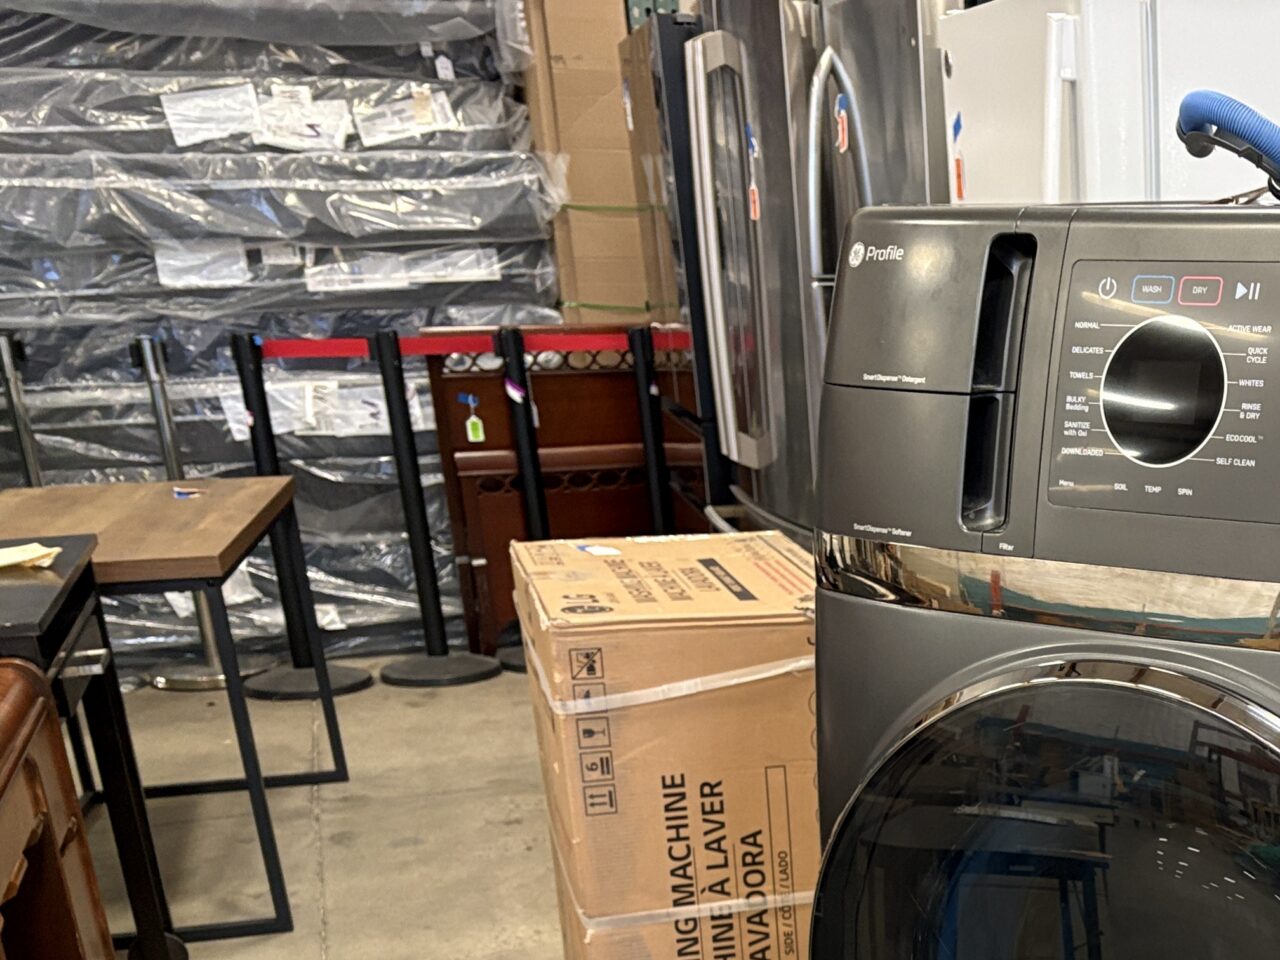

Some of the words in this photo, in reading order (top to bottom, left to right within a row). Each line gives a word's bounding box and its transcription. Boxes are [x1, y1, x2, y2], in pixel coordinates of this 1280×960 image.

[866, 245, 904, 261] Profile
[1142, 285, 1162, 293] WASH
[1192, 286, 1208, 294] DRY
[1074, 321, 1100, 329] NORMAL
[1227, 325, 1251, 333] ACTIVE
[1252, 325, 1272, 333] WEAR
[1071, 346, 1104, 354] DELICATES
[1247, 347, 1269, 355] QUICK
[1246, 356, 1267, 364] CYCLE
[1069, 371, 1094, 379] TOWELS
[1239, 379, 1264, 387] WHITES
[1241, 403, 1262, 411] RINSE
[1246, 412, 1261, 420] DRY
[1064, 421, 1091, 429] SANITIZE
[1061, 447, 1104, 456] DOWNLOADED
[1216, 457, 1233, 465] SELF
[1233, 459, 1256, 467] CLEAN
[1114, 483, 1128, 491] SOIL
[1144, 485, 1162, 493] TEMP
[1177, 488, 1193, 496] SPIN
[700, 780, 729, 871] LAVER
[661, 773, 695, 908] MACHINE
[777, 851, 790, 881] LADO
[700, 877, 731, 897] À
[783, 931, 795, 955] SIDE
